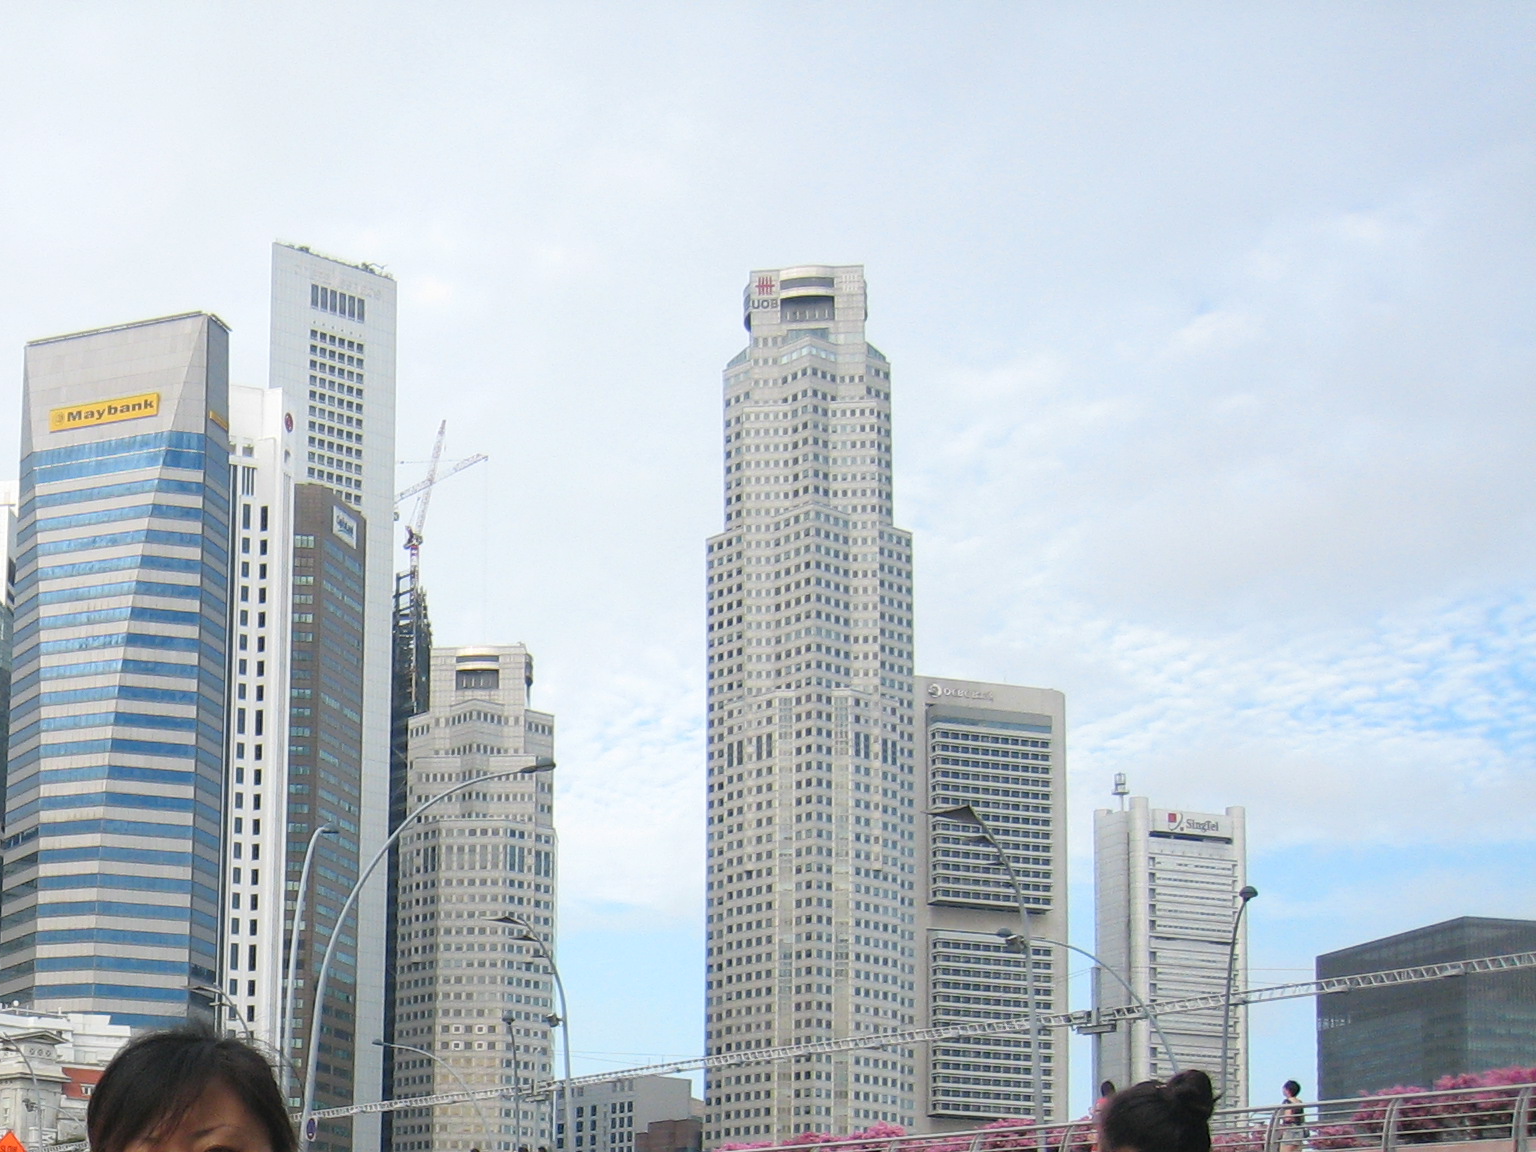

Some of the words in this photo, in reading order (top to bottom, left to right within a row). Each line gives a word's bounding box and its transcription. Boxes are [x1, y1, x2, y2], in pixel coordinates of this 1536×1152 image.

[751, 299, 779, 310] UOB
[67, 399, 154, 422] Maybank
[1186, 818, 1219, 833] SingTel
